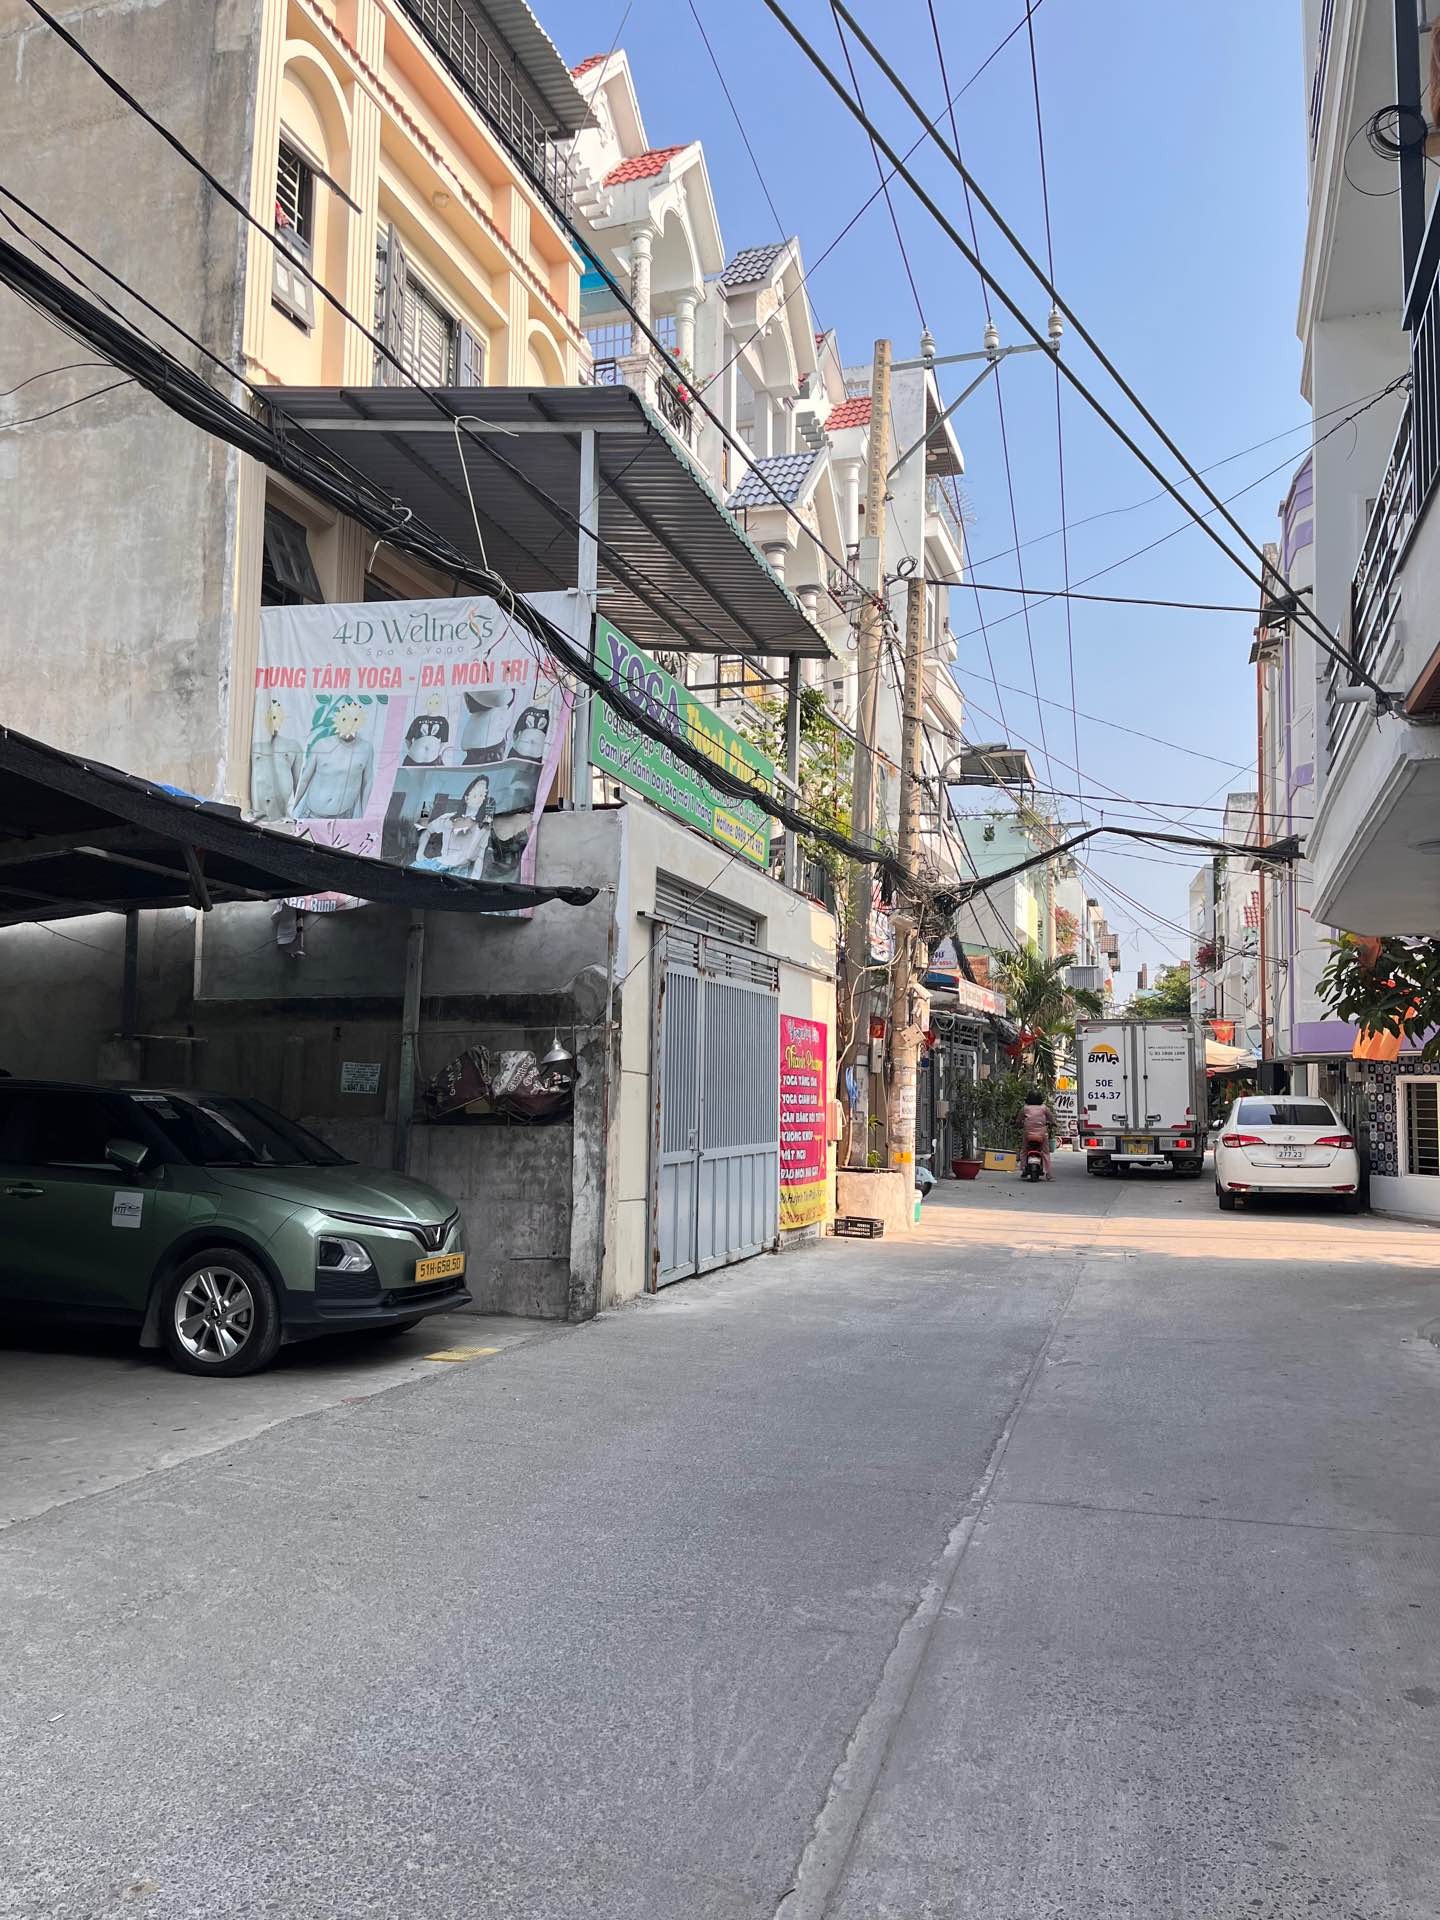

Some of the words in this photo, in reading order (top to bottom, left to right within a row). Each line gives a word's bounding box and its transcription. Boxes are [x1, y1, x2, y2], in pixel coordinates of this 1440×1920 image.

[332, 620, 374, 645] 4D
[381, 607, 494, 649] Wellness
[312, 663, 351, 688] TÂM
[357, 666, 402, 688] YOGA
[421, 664, 446, 688] ĐA
[452, 658, 495, 686] MÔN
[606, 632, 681, 738] YOGA
[1096, 1079, 1113, 1087] 50E
[782, 1094, 798, 1105] YOGA
[1088, 1091, 1120, 1100] 614.37
